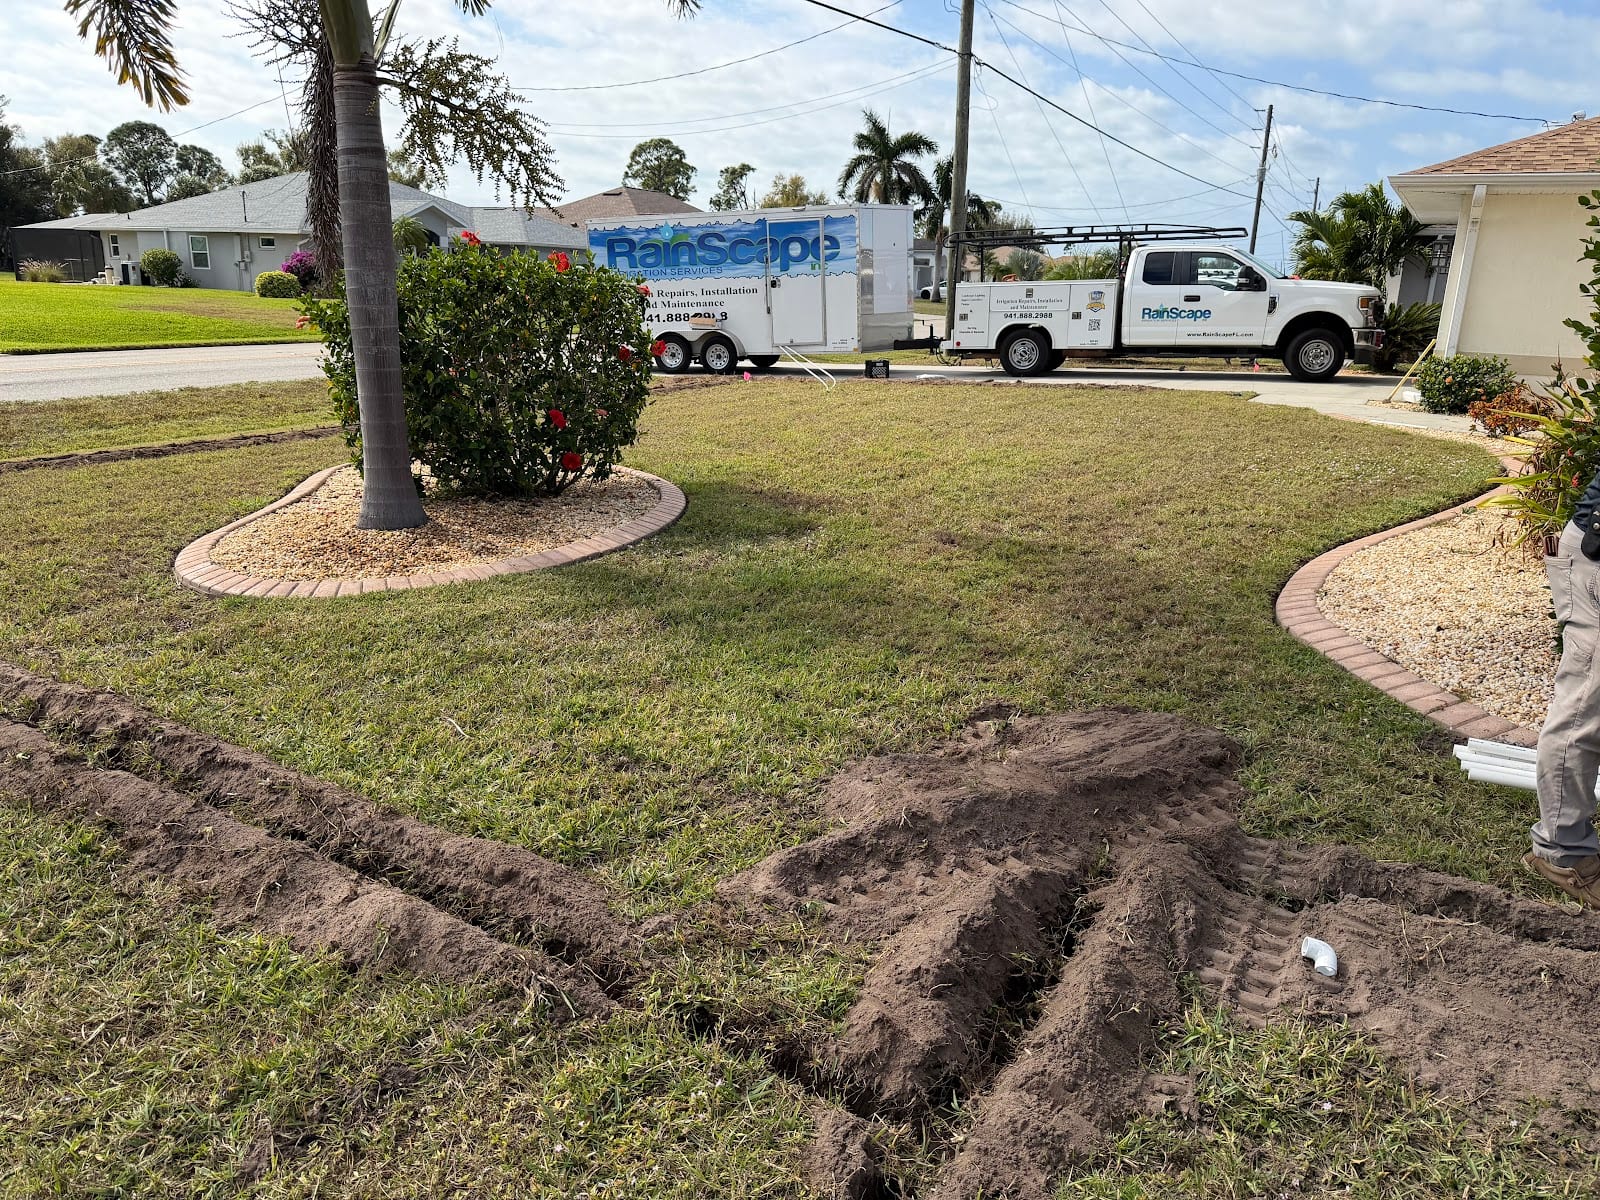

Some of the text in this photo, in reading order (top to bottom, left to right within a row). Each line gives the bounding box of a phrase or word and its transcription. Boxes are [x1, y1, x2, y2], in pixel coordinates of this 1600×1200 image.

[606, 232, 841, 272] RainScape
[670, 266, 723, 276] SERVICES
[657, 289, 698, 299] Repairs,
[701, 286, 758, 296] Installation
[660, 299, 725, 308] Maintenance
[1141, 307, 1212, 322] RainScape
